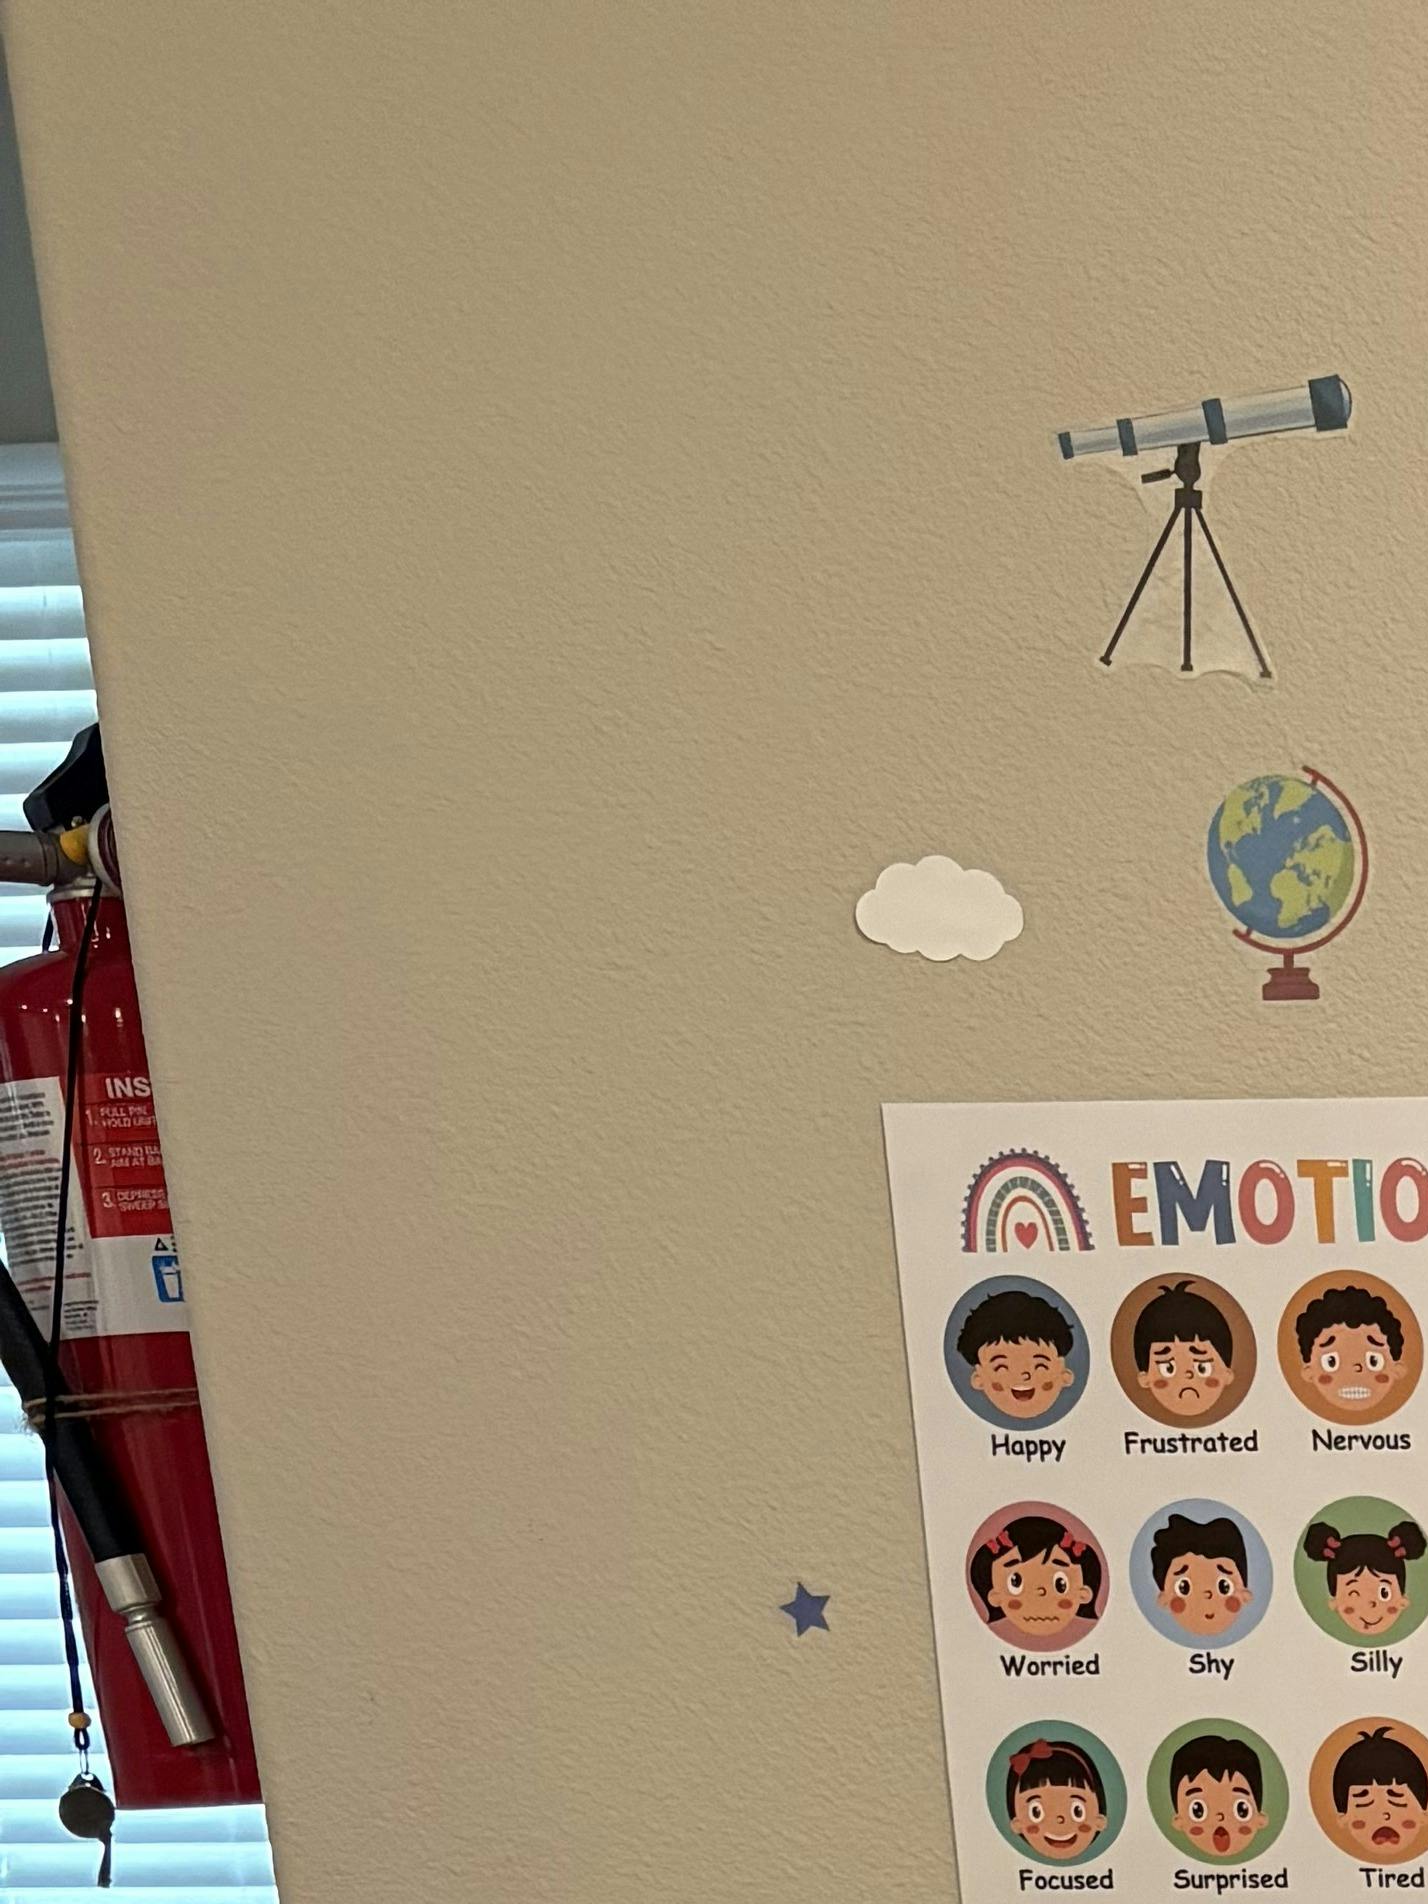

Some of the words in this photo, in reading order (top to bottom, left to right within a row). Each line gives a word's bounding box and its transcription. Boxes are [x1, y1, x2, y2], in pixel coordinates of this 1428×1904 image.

[991, 1433, 1066, 1463] Happy
[1124, 1429, 1258, 1455] Frustrated
[1311, 1429, 1412, 1452] Nervous
[1001, 1654, 1100, 1677] Worried
[1188, 1654, 1235, 1680] Shy
[1350, 1651, 1403, 1679] Silly
[1019, 1869, 1114, 1892] Focused
[1174, 1867, 1288, 1894] Surprised
[1360, 1867, 1425, 1889] Tired
